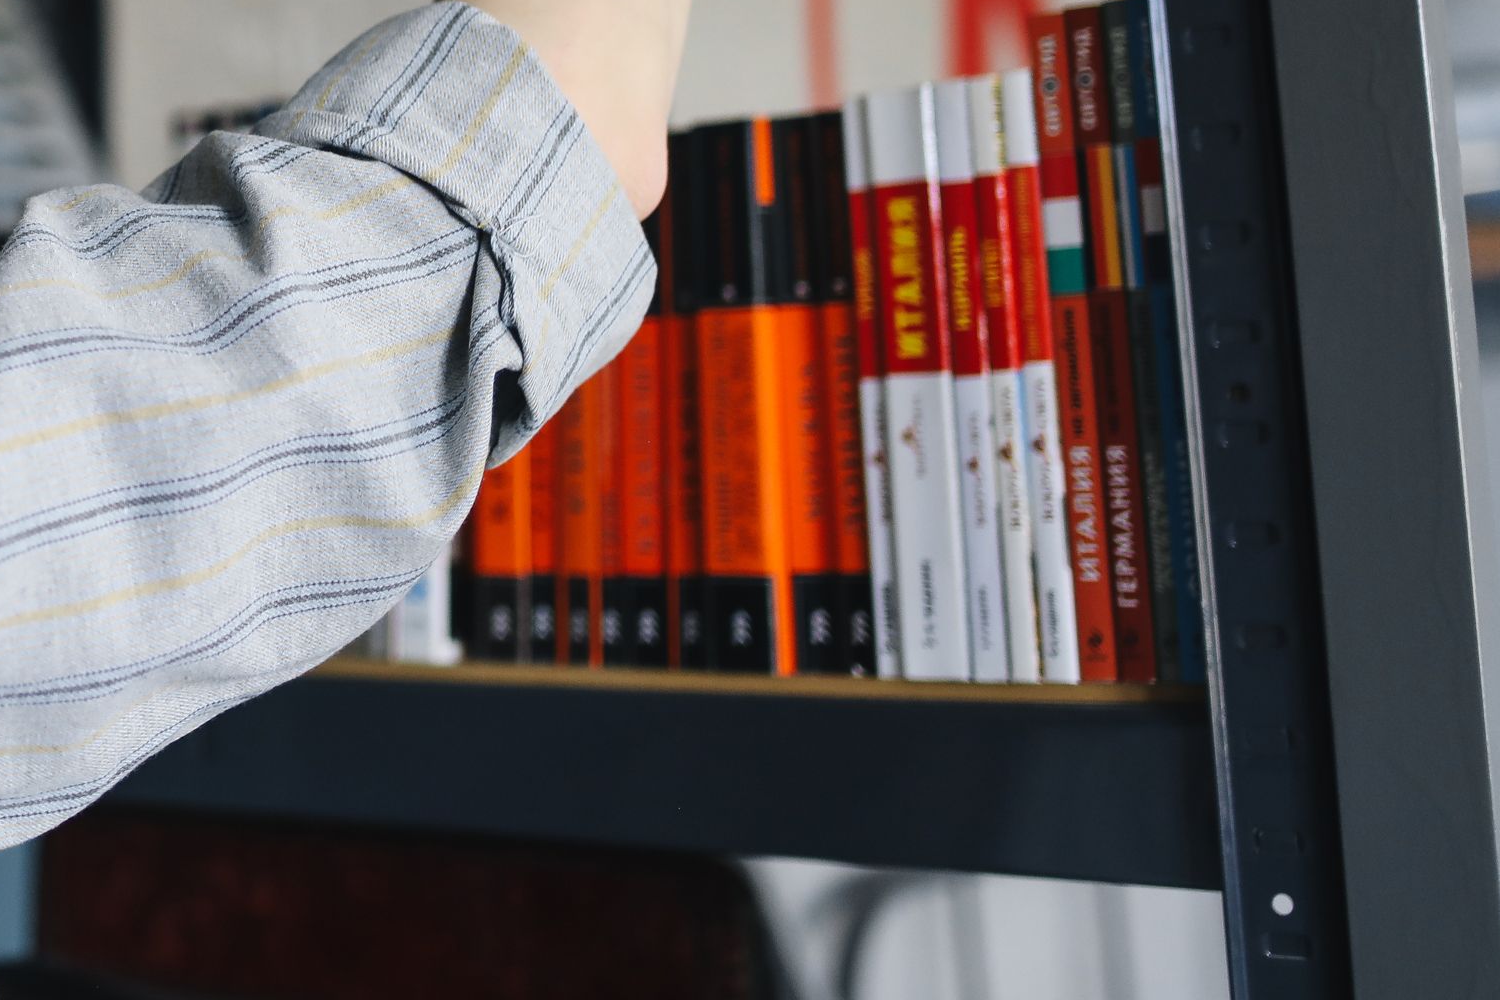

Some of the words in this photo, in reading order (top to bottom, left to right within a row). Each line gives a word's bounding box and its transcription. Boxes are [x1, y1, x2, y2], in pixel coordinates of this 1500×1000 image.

[887, 195, 927, 360] ИТАЛИЯ
[1070, 445, 1100, 583] ИТАЛИЯ
[1106, 444, 1140, 609] ГЕРМАНИЯ
